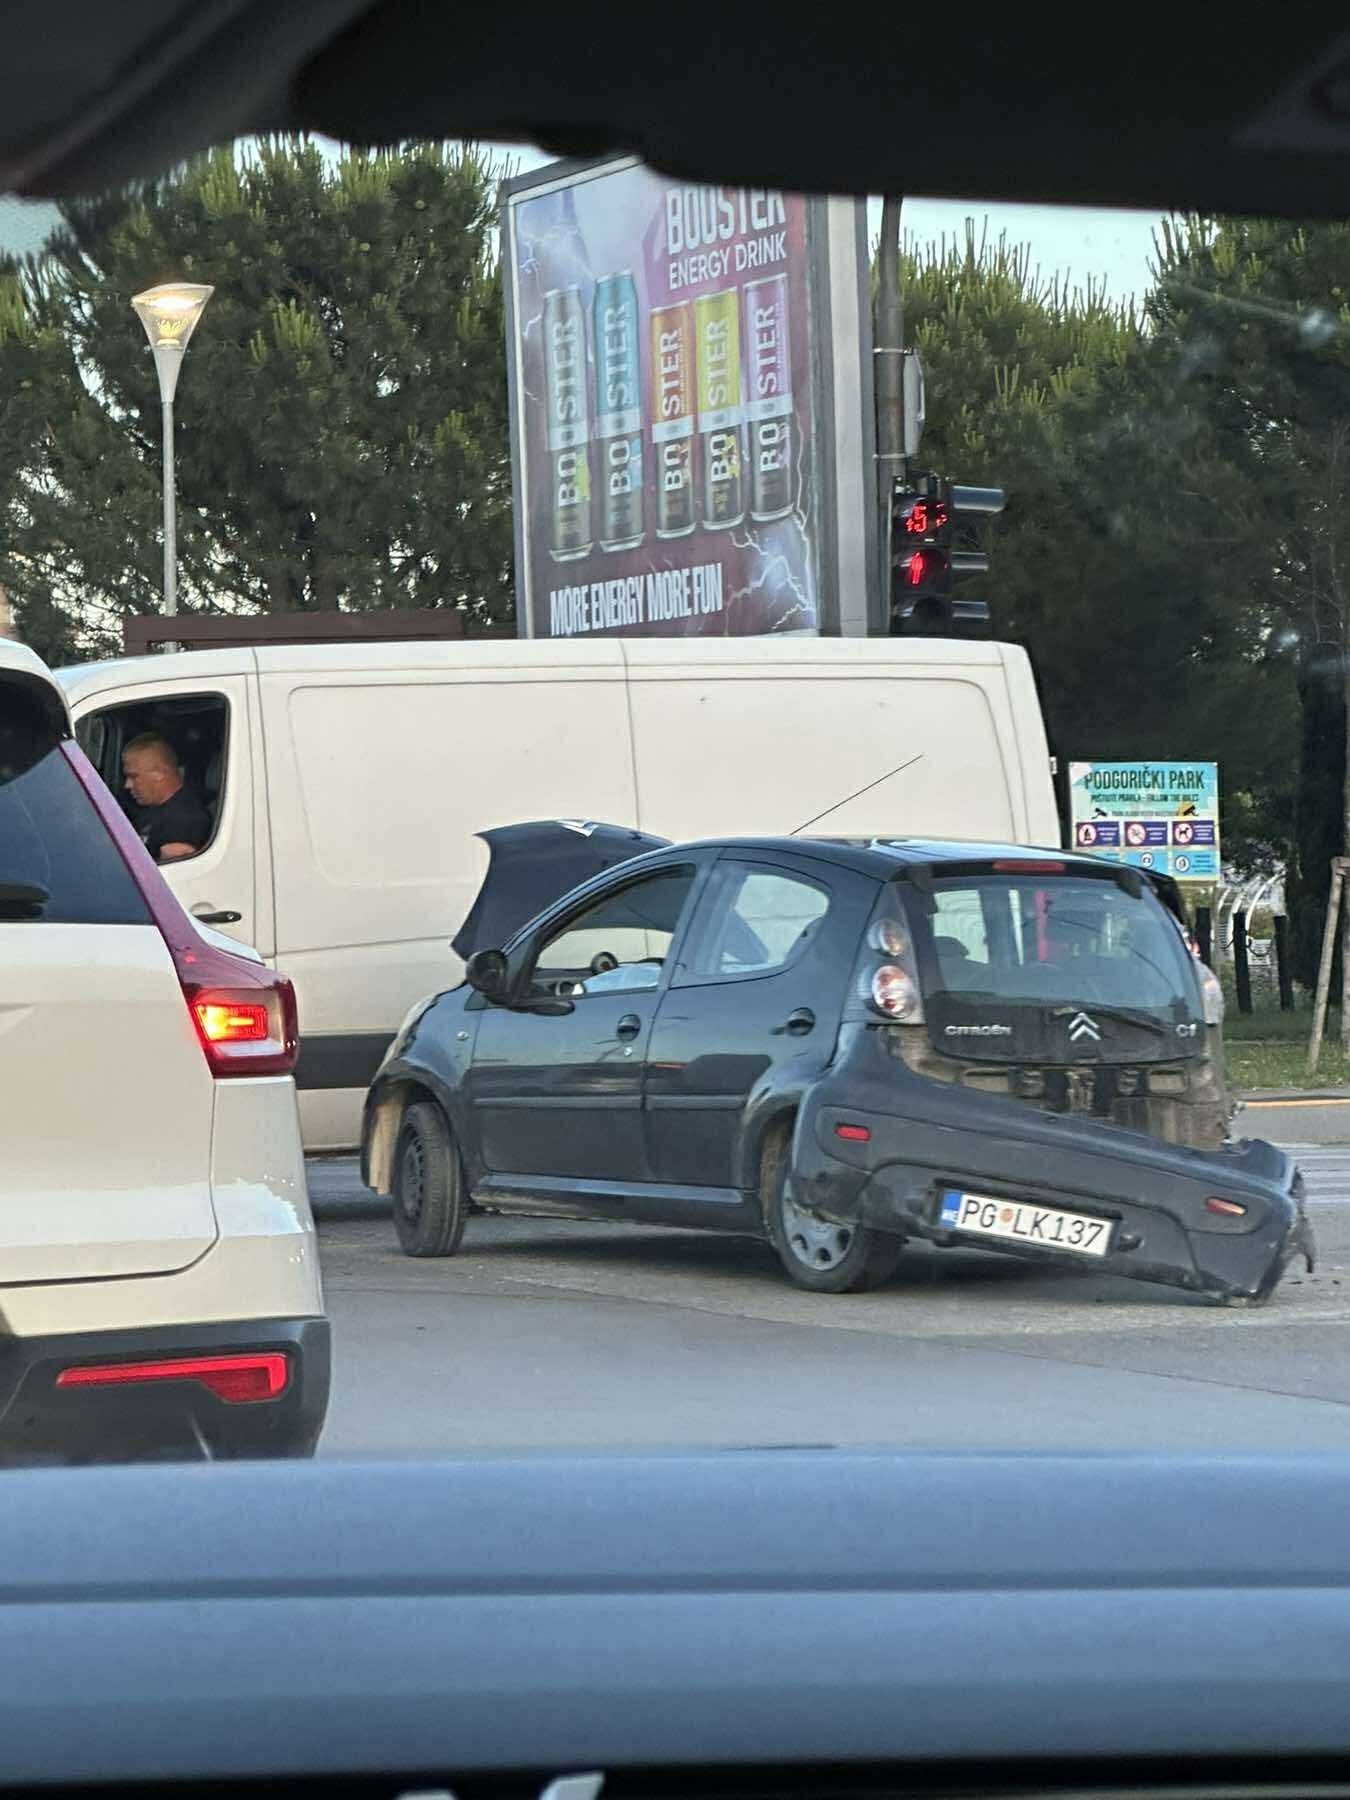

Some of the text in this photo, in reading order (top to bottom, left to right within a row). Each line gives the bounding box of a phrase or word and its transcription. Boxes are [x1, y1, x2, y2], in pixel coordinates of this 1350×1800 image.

[669, 231, 786, 290] ENERGY DRINK
[550, 562, 723, 637] MORE ENERGY MORE FUN
[1084, 765, 1205, 789] PODGORIČKI PARK
[961, 1199, 1105, 1248] PG LK137
